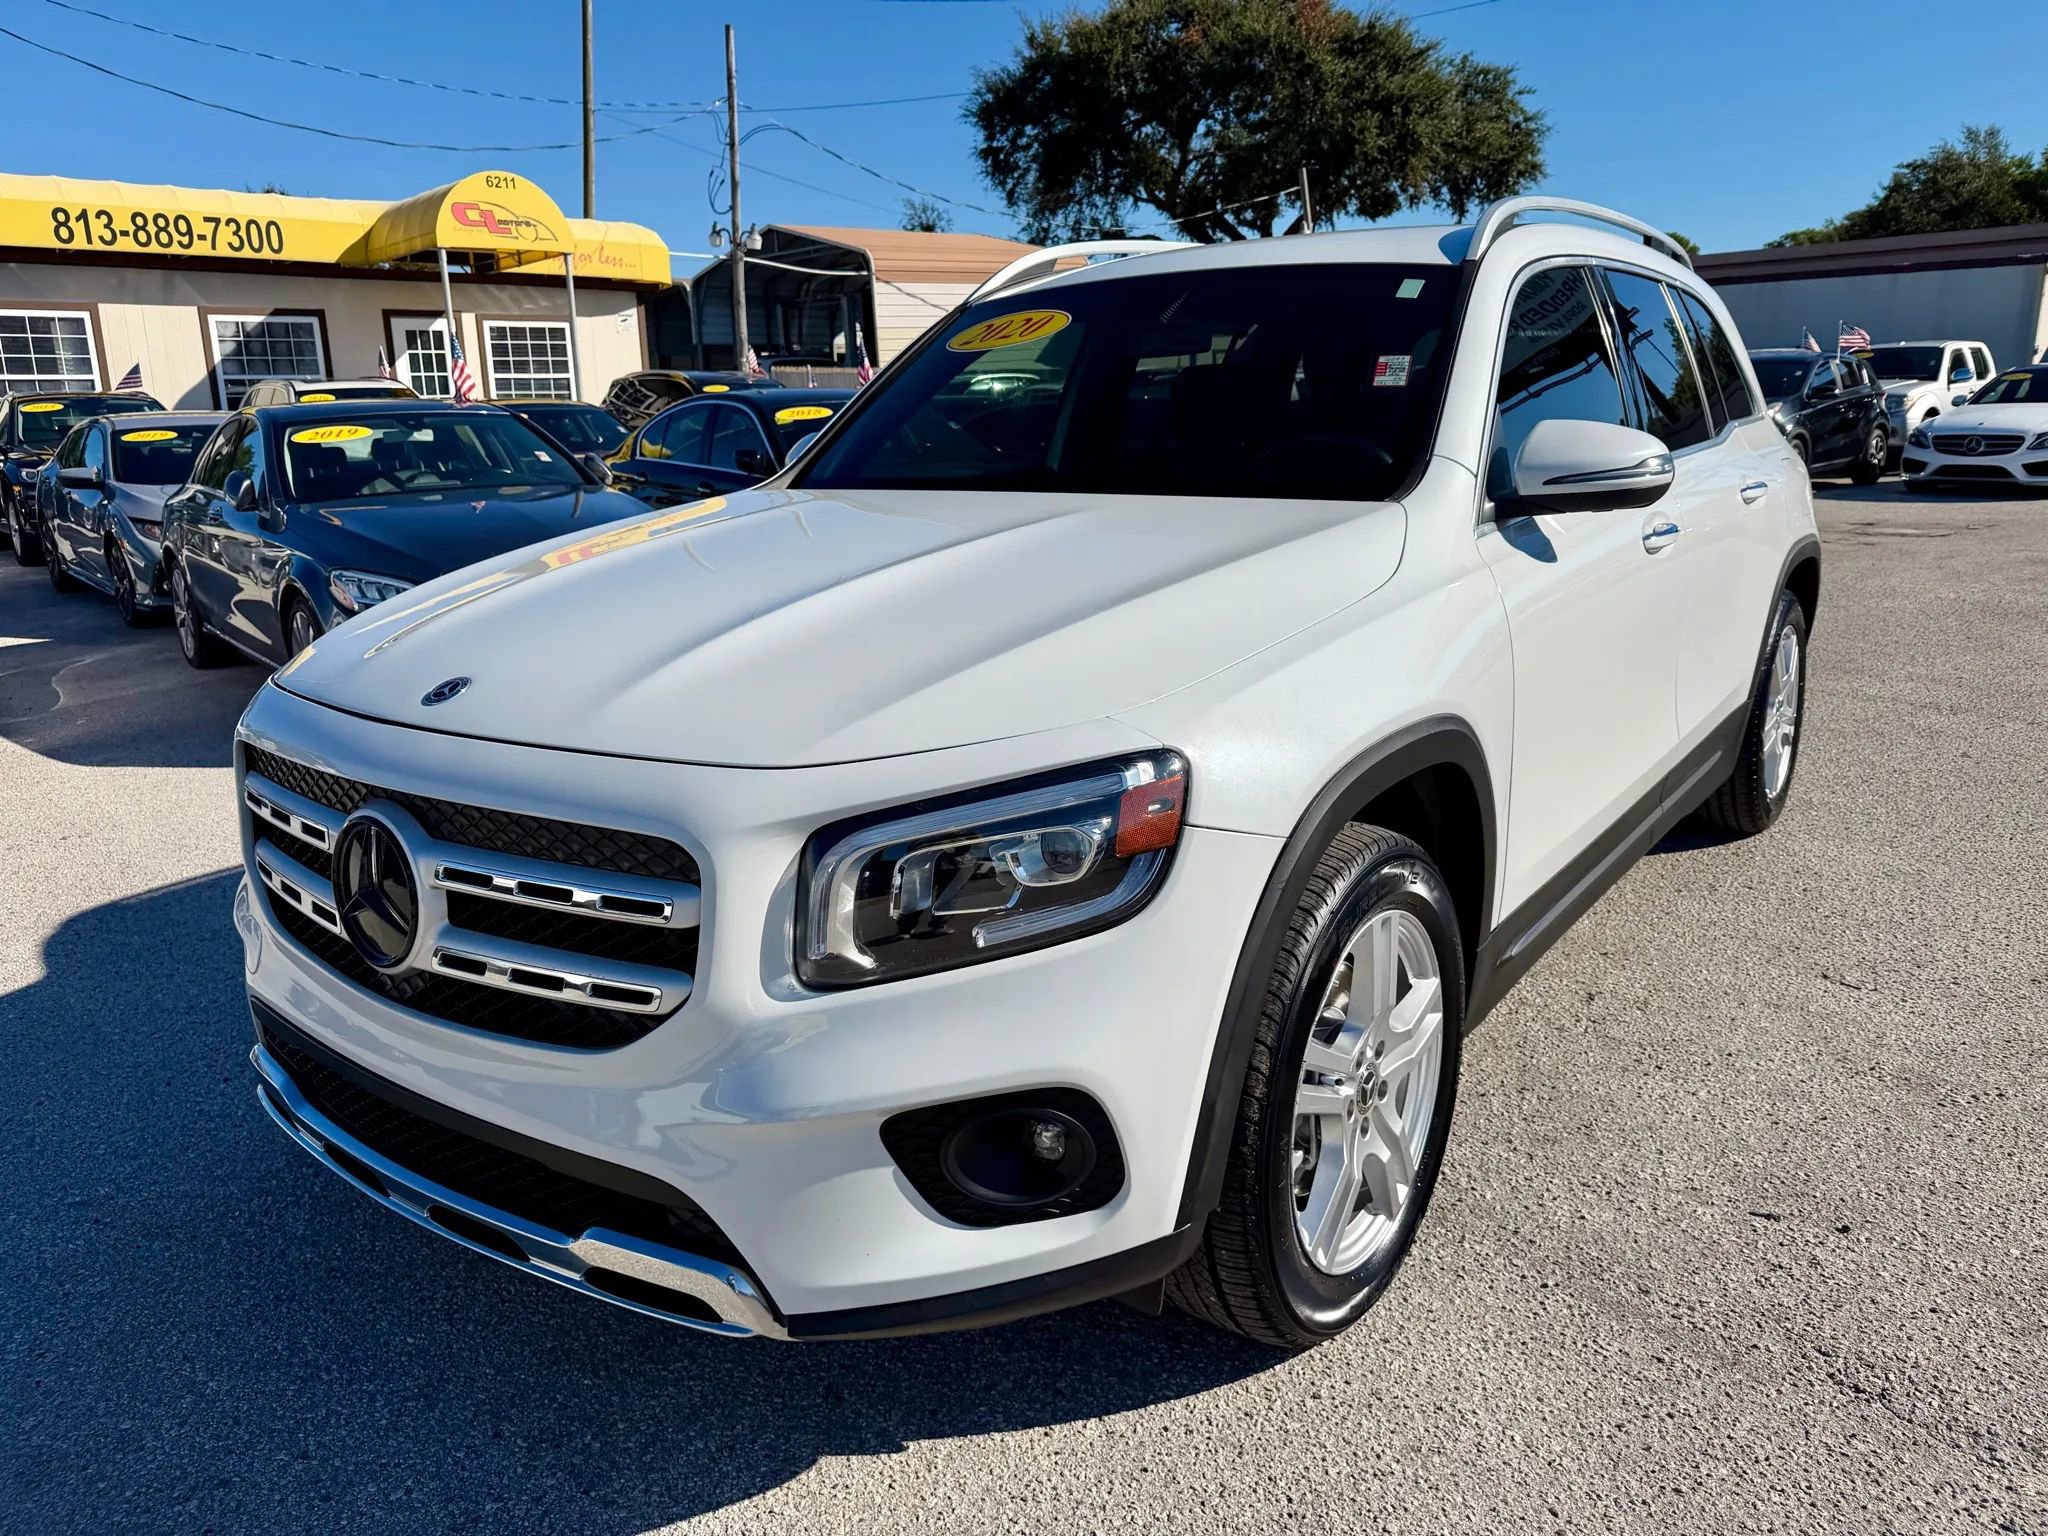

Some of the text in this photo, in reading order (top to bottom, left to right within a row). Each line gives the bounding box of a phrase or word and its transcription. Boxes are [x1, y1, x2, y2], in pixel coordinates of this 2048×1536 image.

[485, 175, 516, 190] 6211
[51, 206, 284, 254] 813-889-7300
[451, 202, 512, 235] CL
[958, 314, 1055, 346] 2020
[308, 428, 358, 441] 2019
